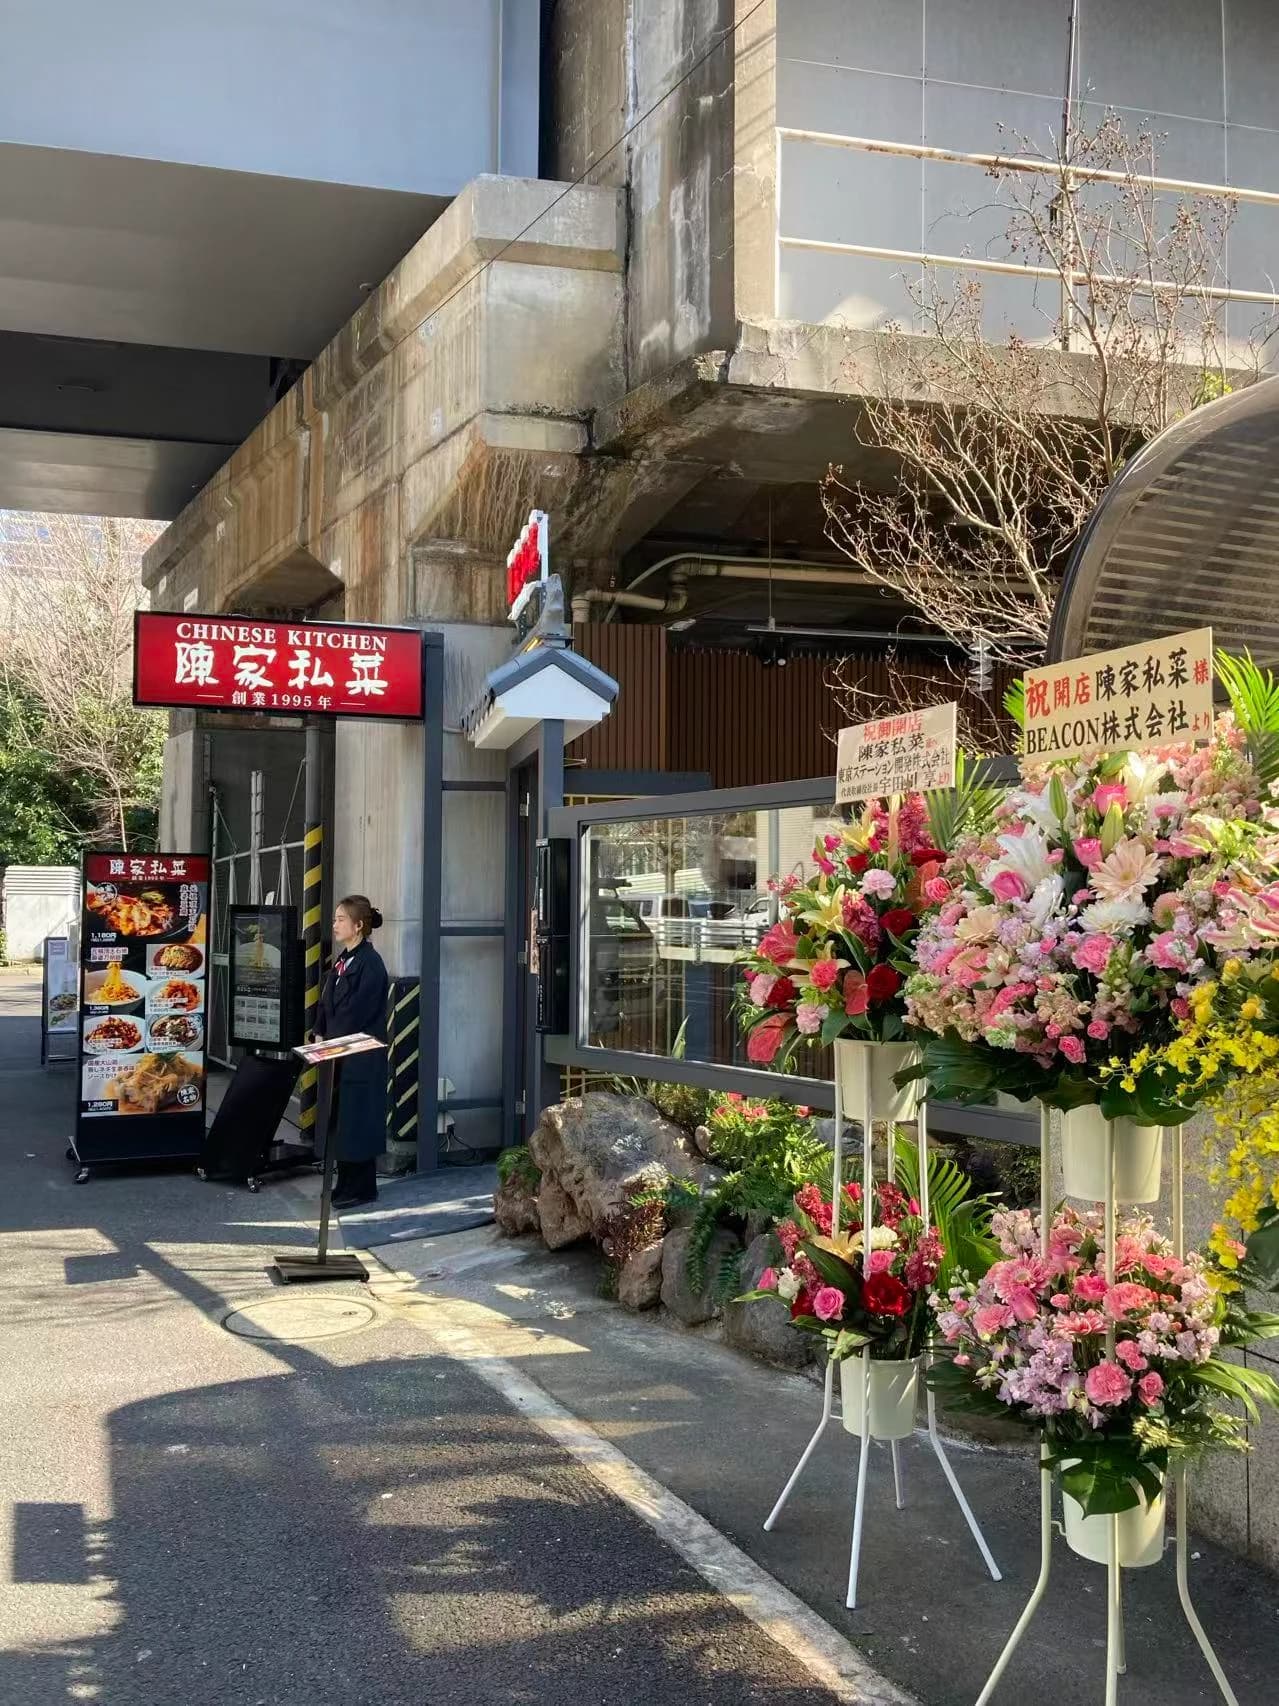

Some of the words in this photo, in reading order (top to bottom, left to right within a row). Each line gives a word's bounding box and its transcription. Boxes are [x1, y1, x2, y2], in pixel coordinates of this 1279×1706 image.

[176, 623, 276, 644] CHINESE
[287, 628, 388, 652] KITCHEN
[174, 641, 389, 697] 陳家私菜
[231, 690, 333, 710] 創業1995年
[109, 859, 187, 876] 陳家私菜
